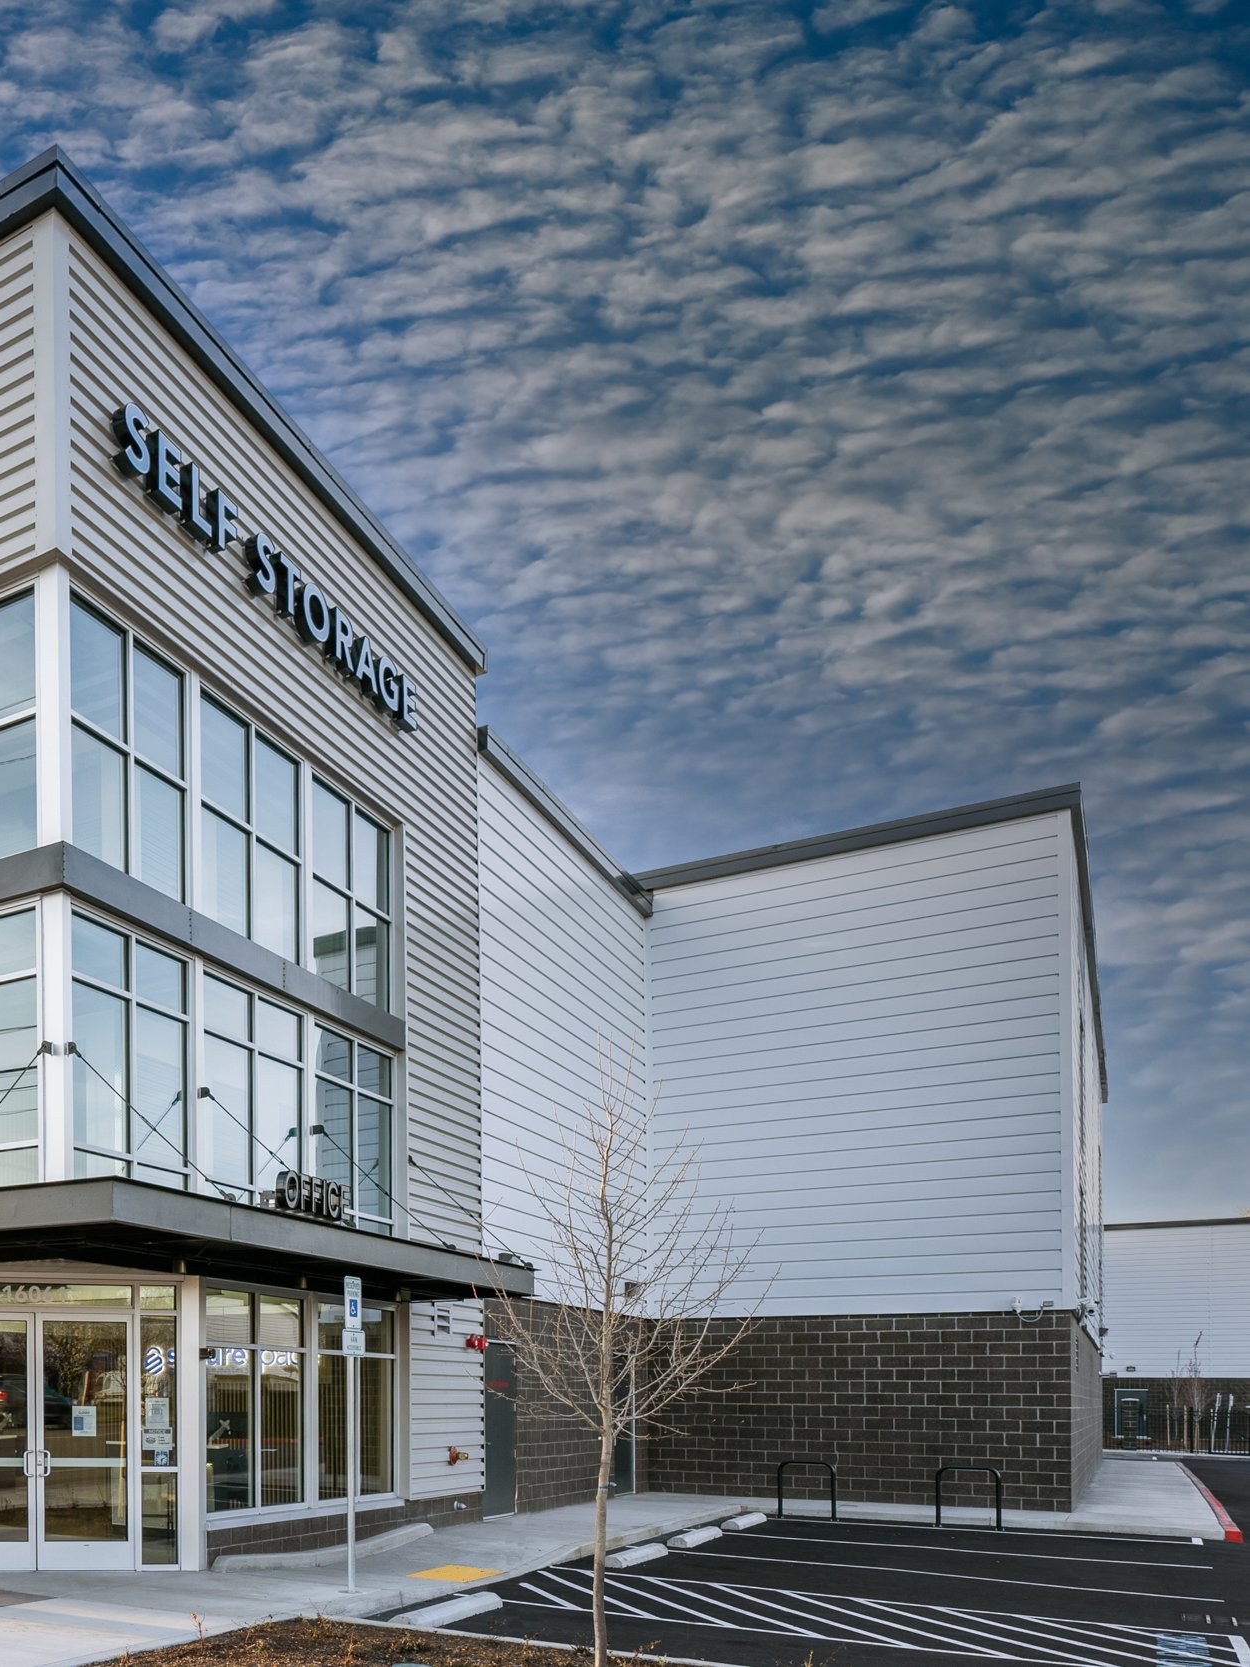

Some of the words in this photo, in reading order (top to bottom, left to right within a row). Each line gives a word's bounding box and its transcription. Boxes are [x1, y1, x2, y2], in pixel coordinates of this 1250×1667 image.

[115, 402, 238, 551] SELF
[250, 532, 418, 731] STORAGE
[279, 1170, 351, 1221] OFFICE
